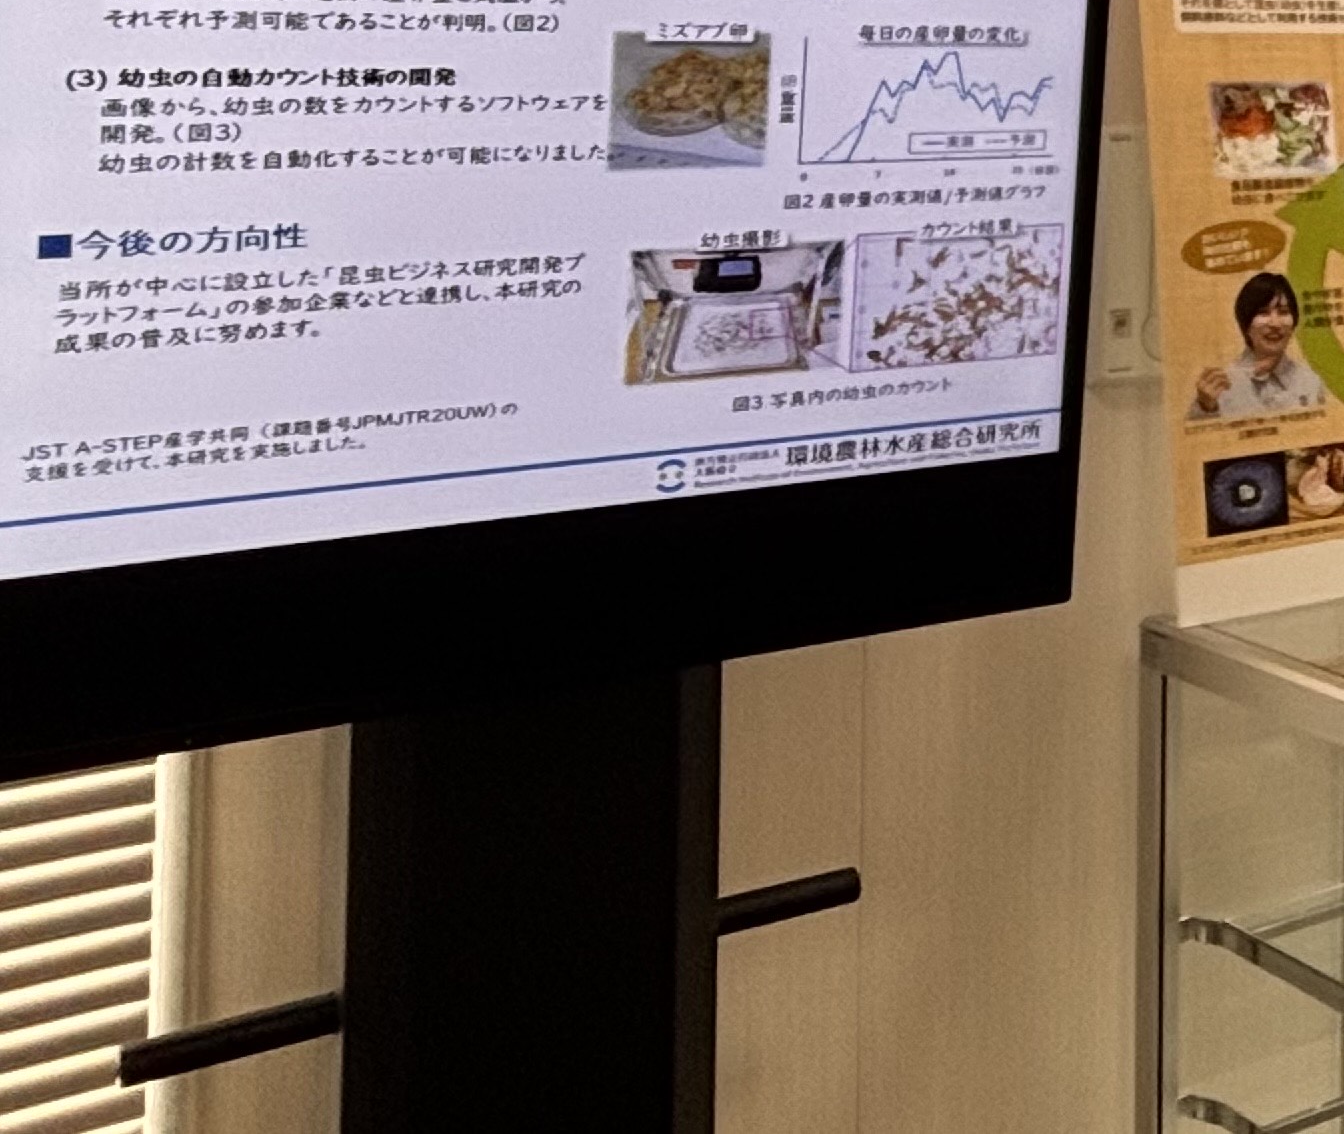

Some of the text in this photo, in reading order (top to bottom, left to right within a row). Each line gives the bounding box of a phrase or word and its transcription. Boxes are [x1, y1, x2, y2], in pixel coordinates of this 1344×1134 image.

[657, 23, 749, 40] ミズアブ卵
[860, 25, 1020, 45] 毎日の産卵量の変化
[119, 67, 456, 90] 幼虫の自動カウント技術の開発
[101, 94, 608, 120] 画像から、幼虫の数をカウントするソフトウェアを
[921, 217, 1015, 236] カウント結果
[77, 222, 308, 260] 今後の方向性
[700, 230, 781, 248] 幼虫撮影
[53, 320, 321, 355] 成果の普及に努めます。
[21, 441, 66, 462] JST
[785, 419, 1042, 467] 環境農林水産総合研究所
